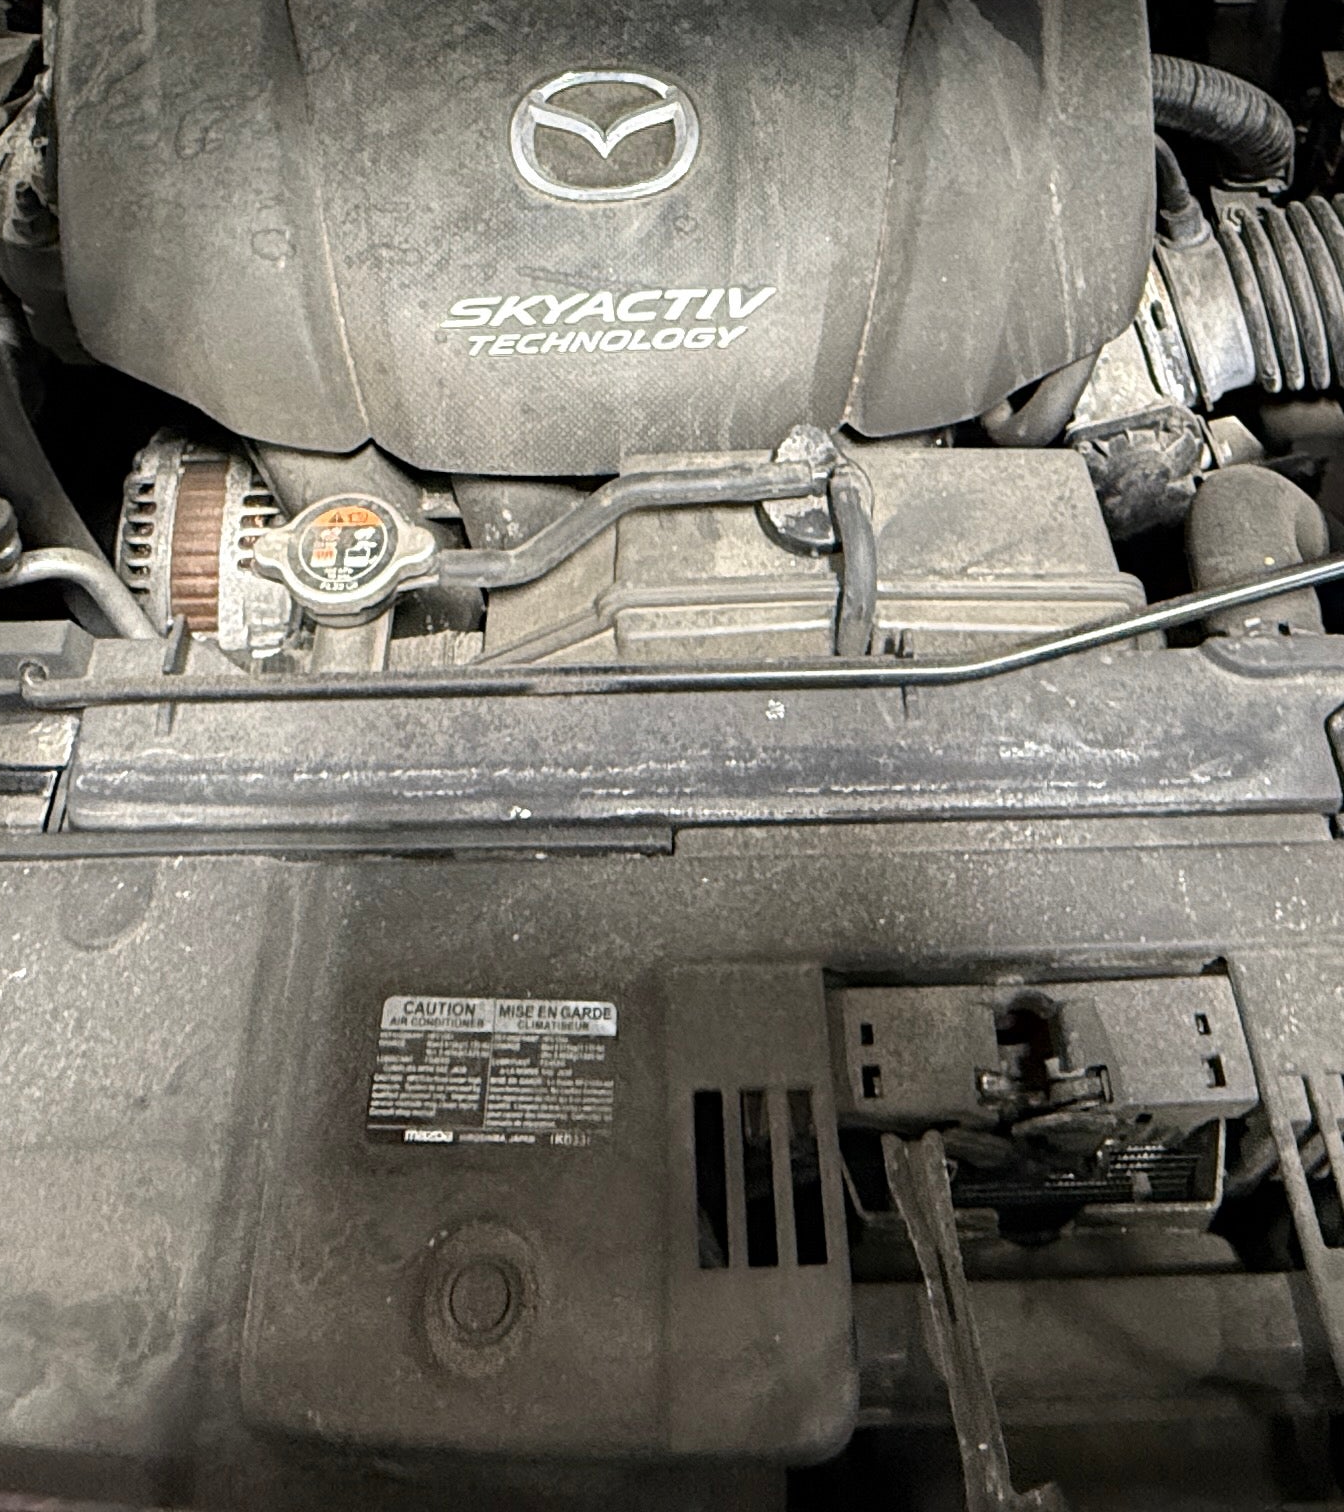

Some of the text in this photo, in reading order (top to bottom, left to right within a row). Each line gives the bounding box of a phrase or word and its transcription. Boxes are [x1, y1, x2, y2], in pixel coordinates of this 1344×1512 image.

[441, 287, 777, 329] SKYACTIV
[467, 325, 749, 358] TECHNOLOGY
[403, 1000, 477, 1017] CAUTION
[498, 1003, 613, 1020] MISE EN GARDE
[389, 1016, 485, 1029] AIR CONDITIONER
[517, 1019, 590, 1031] CLIMATISEUR
